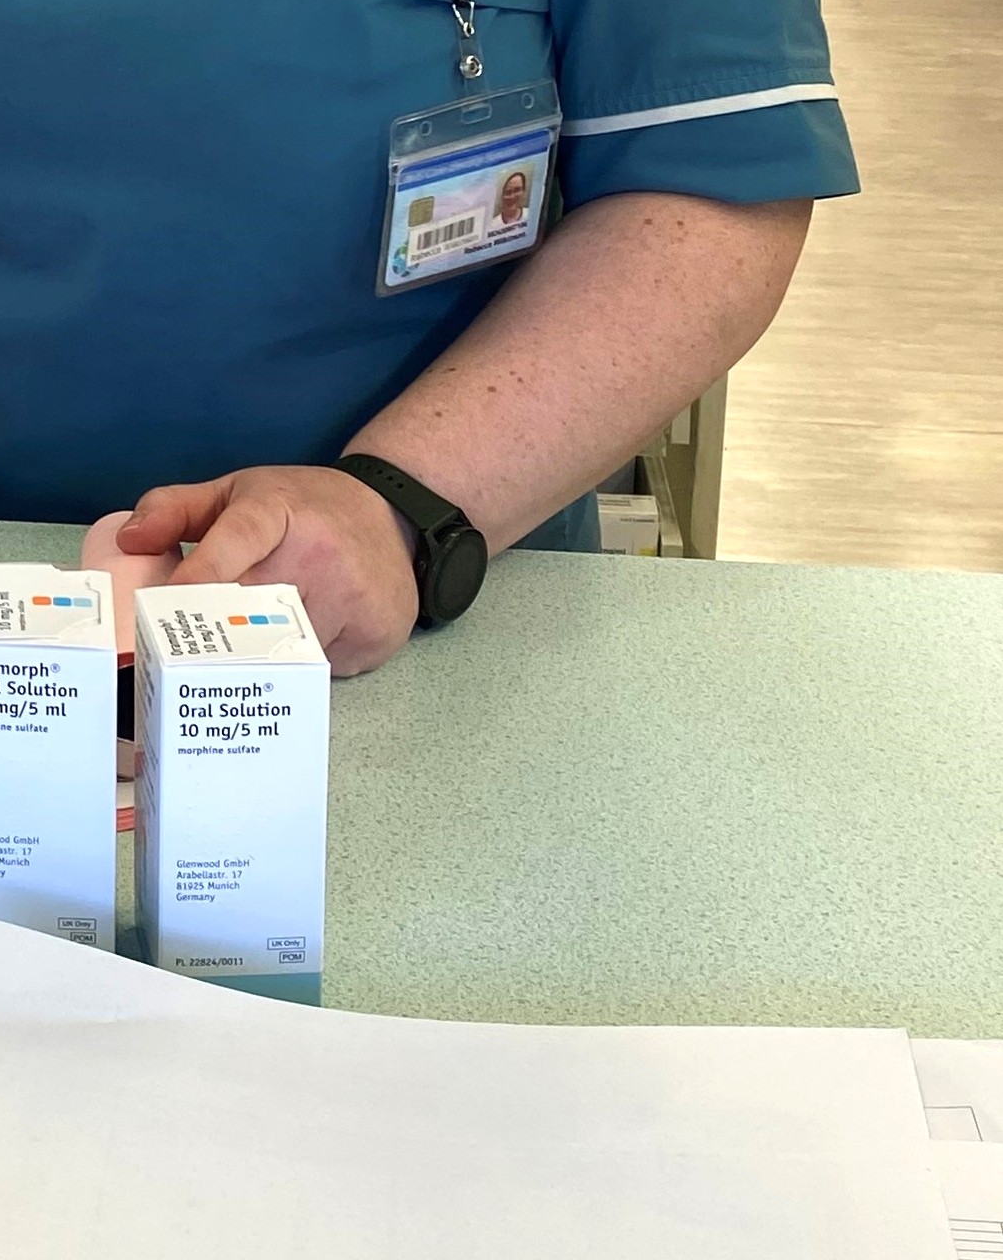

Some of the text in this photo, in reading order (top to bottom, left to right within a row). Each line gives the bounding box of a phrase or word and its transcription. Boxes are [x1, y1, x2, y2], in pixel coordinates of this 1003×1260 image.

[7, 681, 79, 699] Solution
[179, 682, 274, 700] Oramorph®
[46, 703, 67, 717] ml
[179, 702, 291, 718] Oral Solution
[15, 723, 48, 734] sulfate
[180, 722, 279, 740] 10 mg/5 ml
[178, 745, 260, 757] morphine sulfate
[176, 859, 250, 868] Glenwood GmbH
[176, 881, 240, 890] 81925 Munich
[176, 893, 215, 902] Germany
[176, 957, 243, 967] PL 22824/0011
[282, 953, 302, 961] POM
